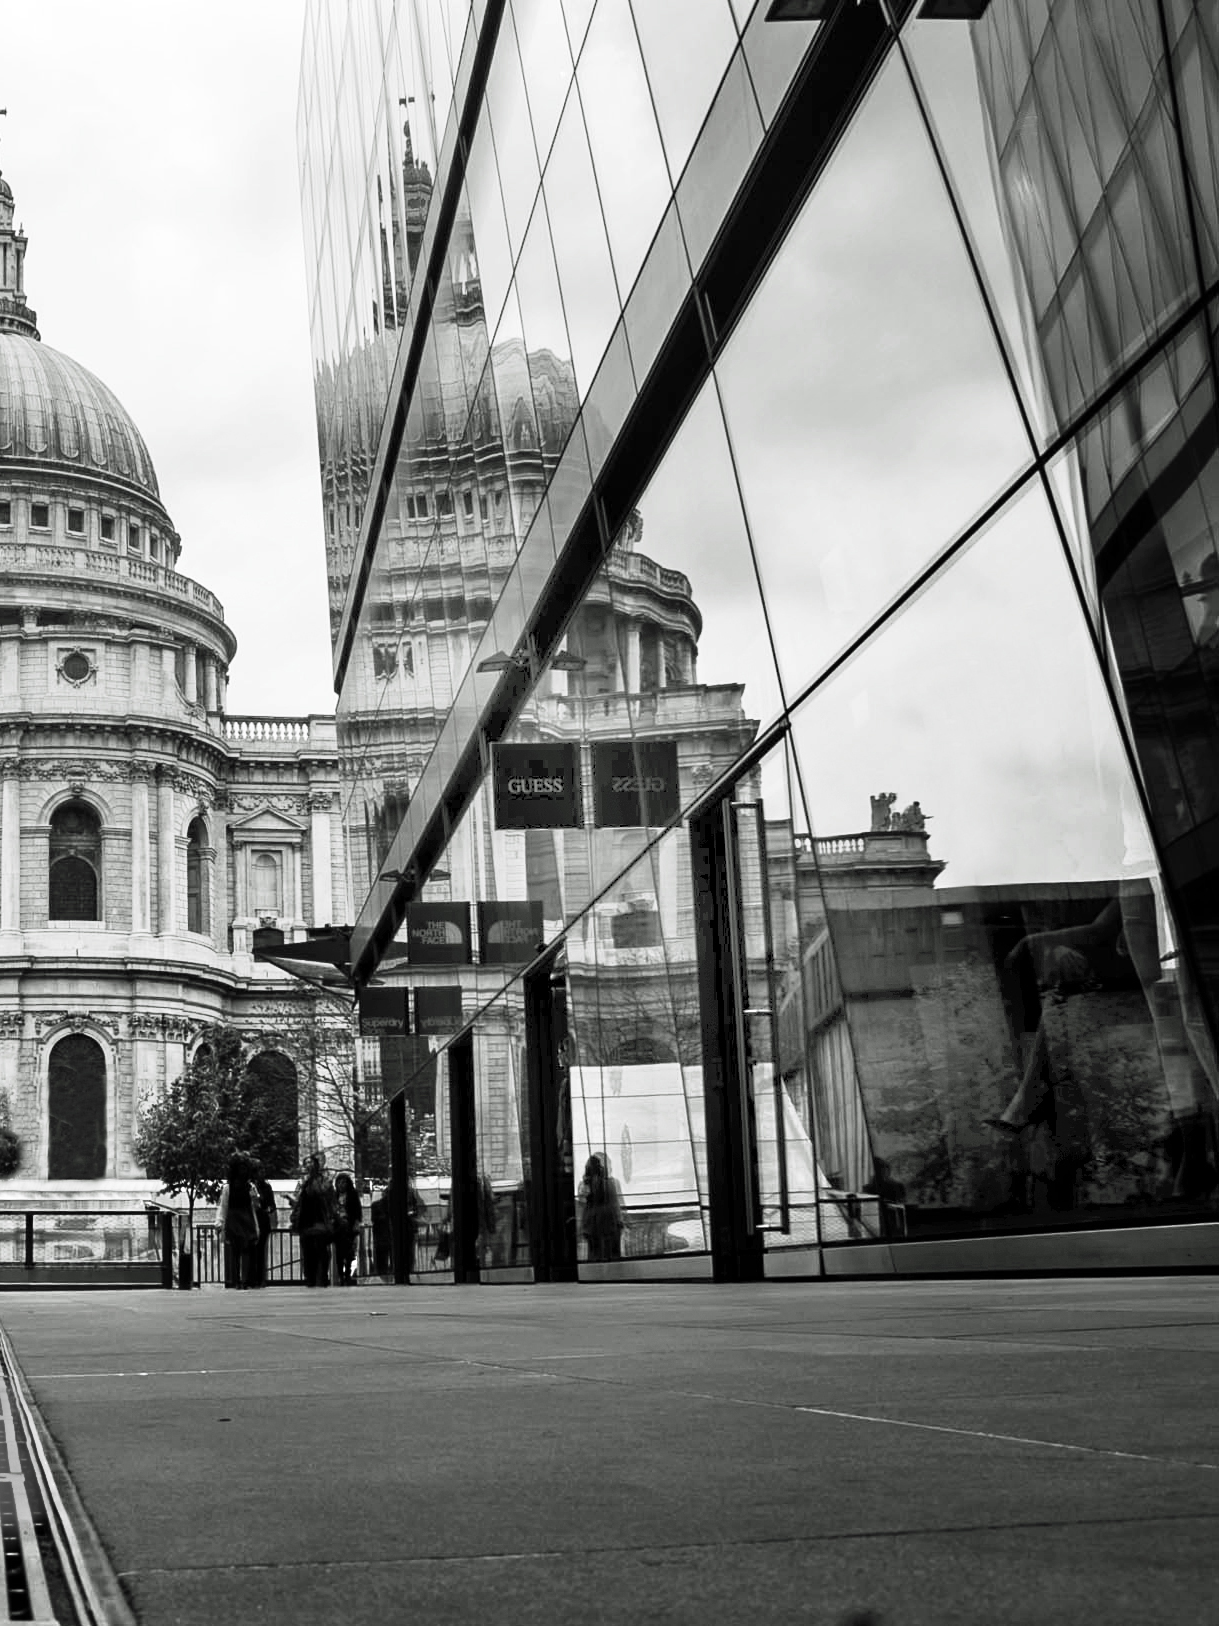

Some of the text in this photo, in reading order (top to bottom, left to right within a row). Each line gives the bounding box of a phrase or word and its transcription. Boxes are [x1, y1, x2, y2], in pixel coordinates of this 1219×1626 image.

[507, 777, 563, 794] GUESS
[427, 921, 445, 929] THE
[412, 928, 445, 937] NORTH
[421, 936, 445, 945] FACE
[361, 1017, 404, 1029] Superdry
